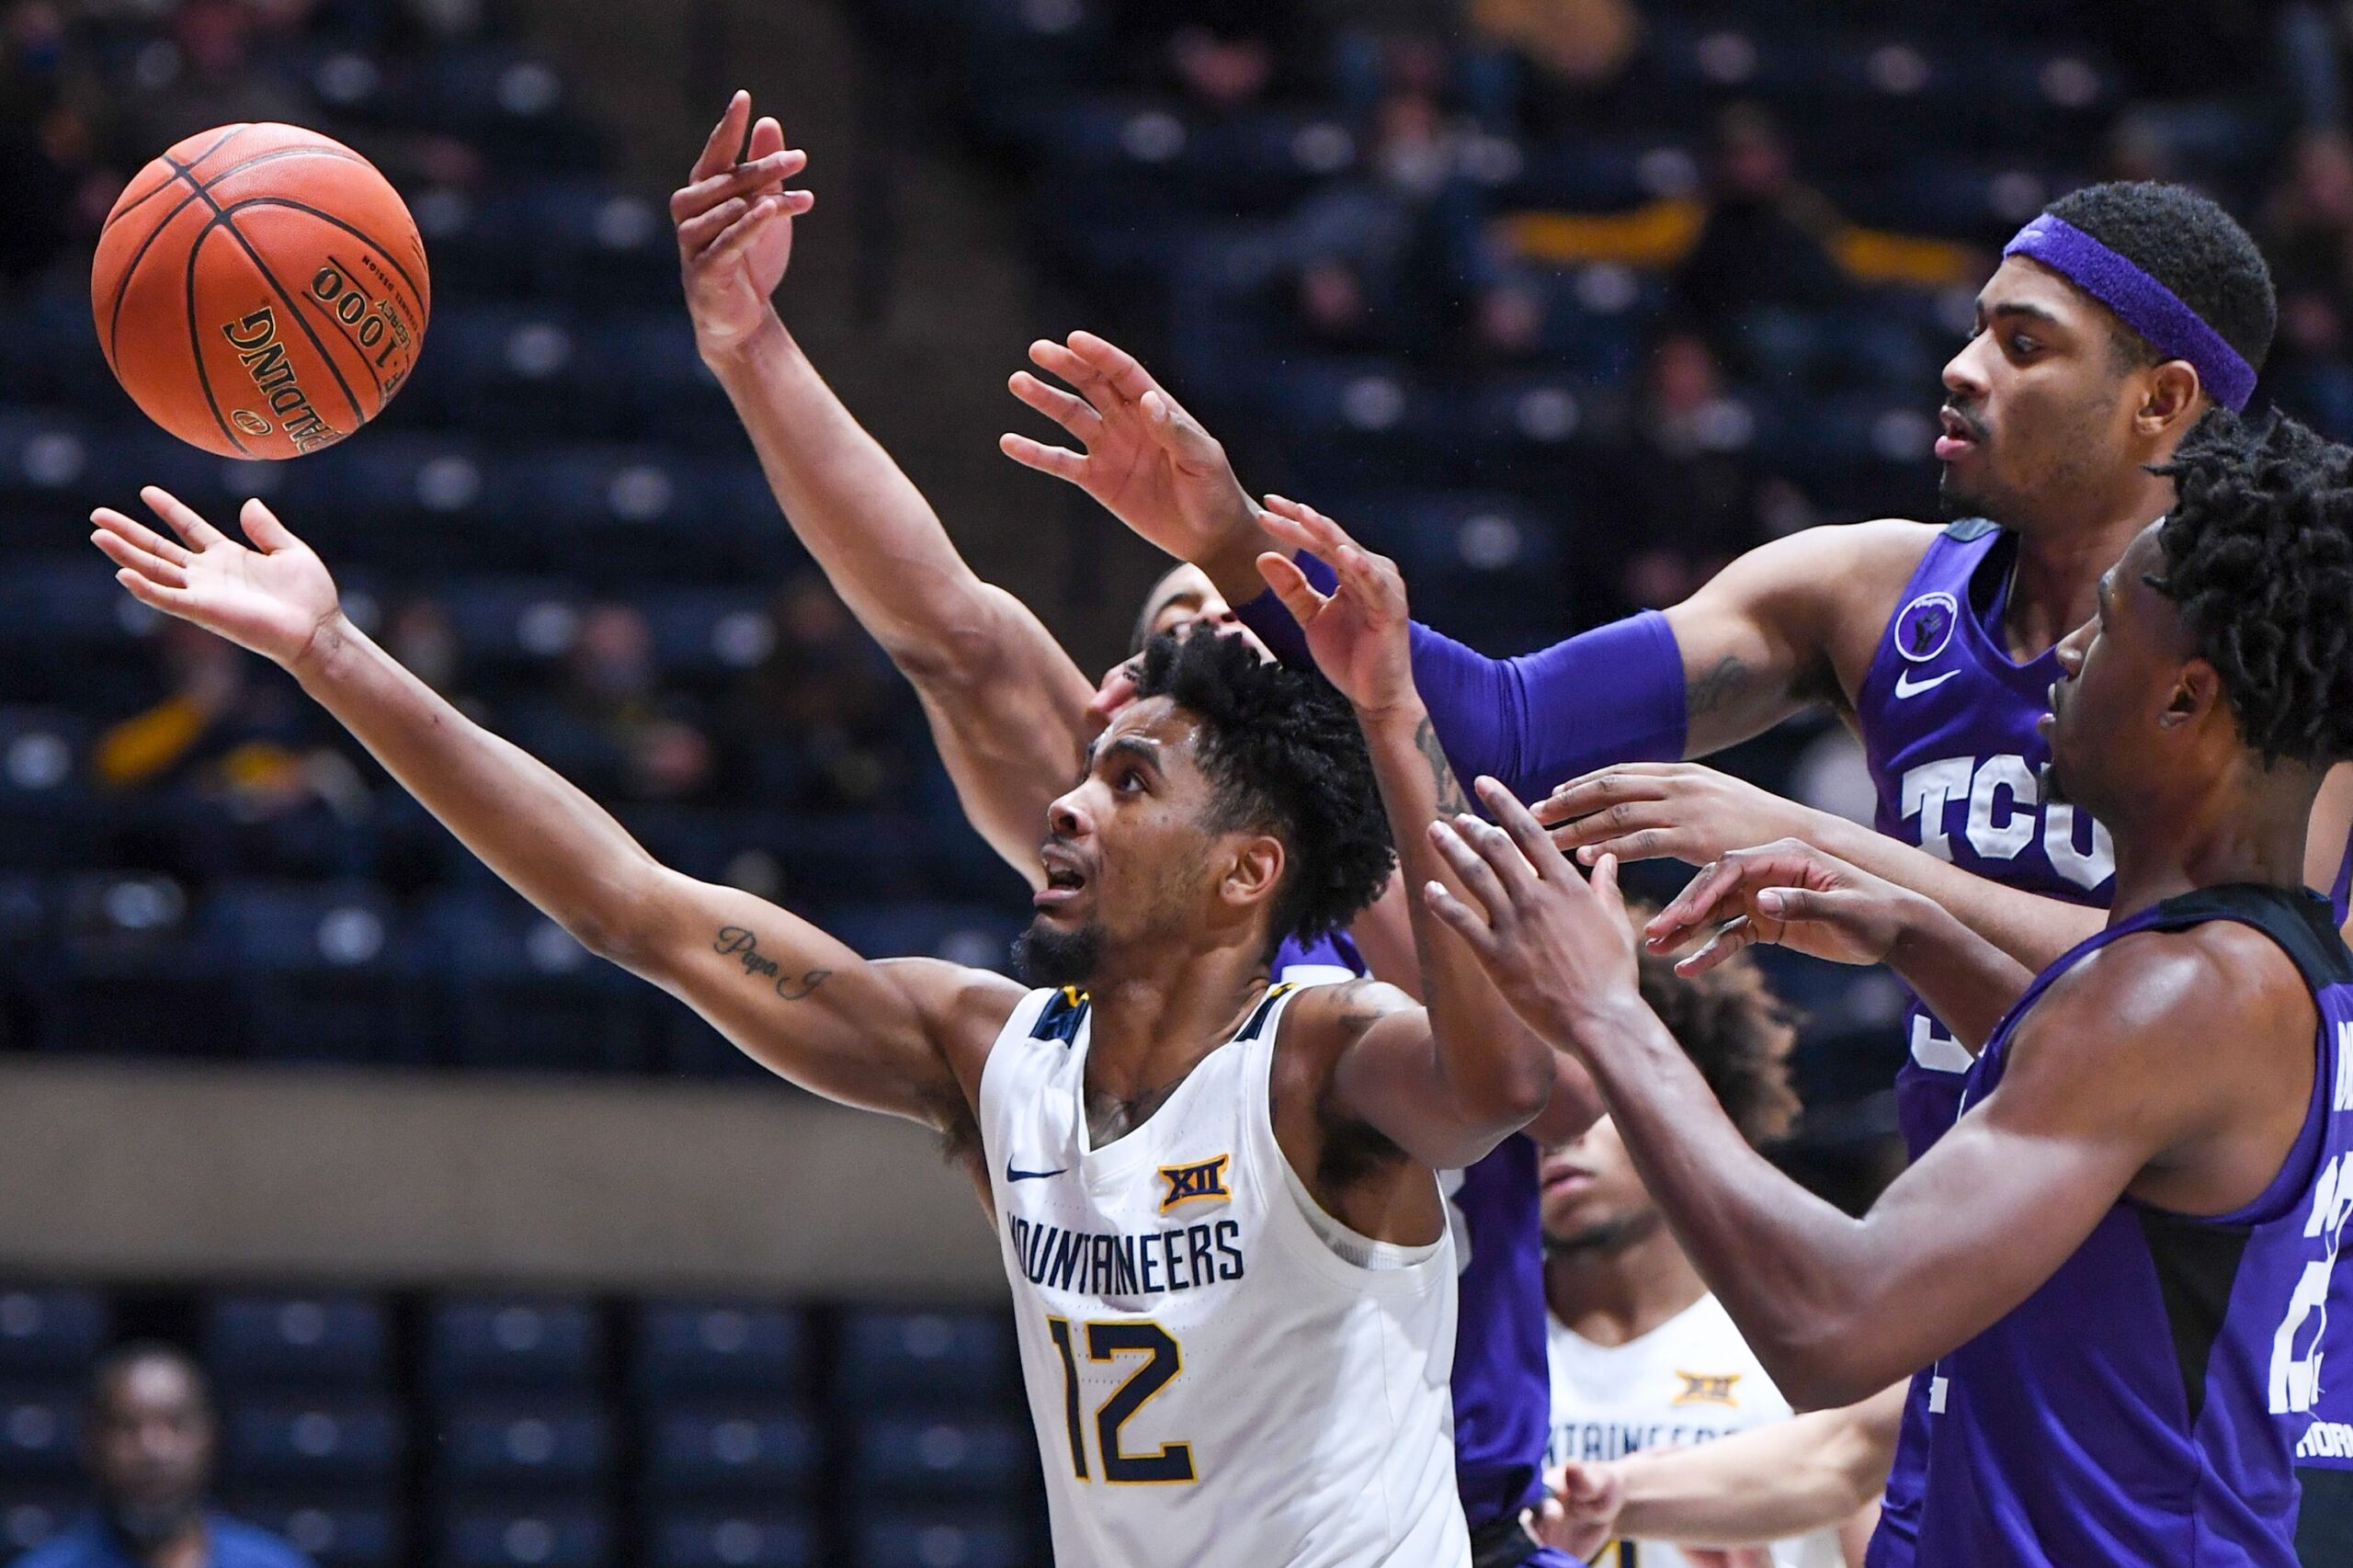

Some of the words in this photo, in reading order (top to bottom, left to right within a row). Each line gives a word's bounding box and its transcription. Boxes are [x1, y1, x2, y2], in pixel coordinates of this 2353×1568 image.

[361, 256, 395, 292] DESIGN
[374, 298, 412, 350] LEGACY
[221, 306, 347, 454] PALDING
[713, 926, 779, 977] Papa
[1160, 1154, 1231, 1212] XII
[1047, 1314, 1199, 1485] 12
